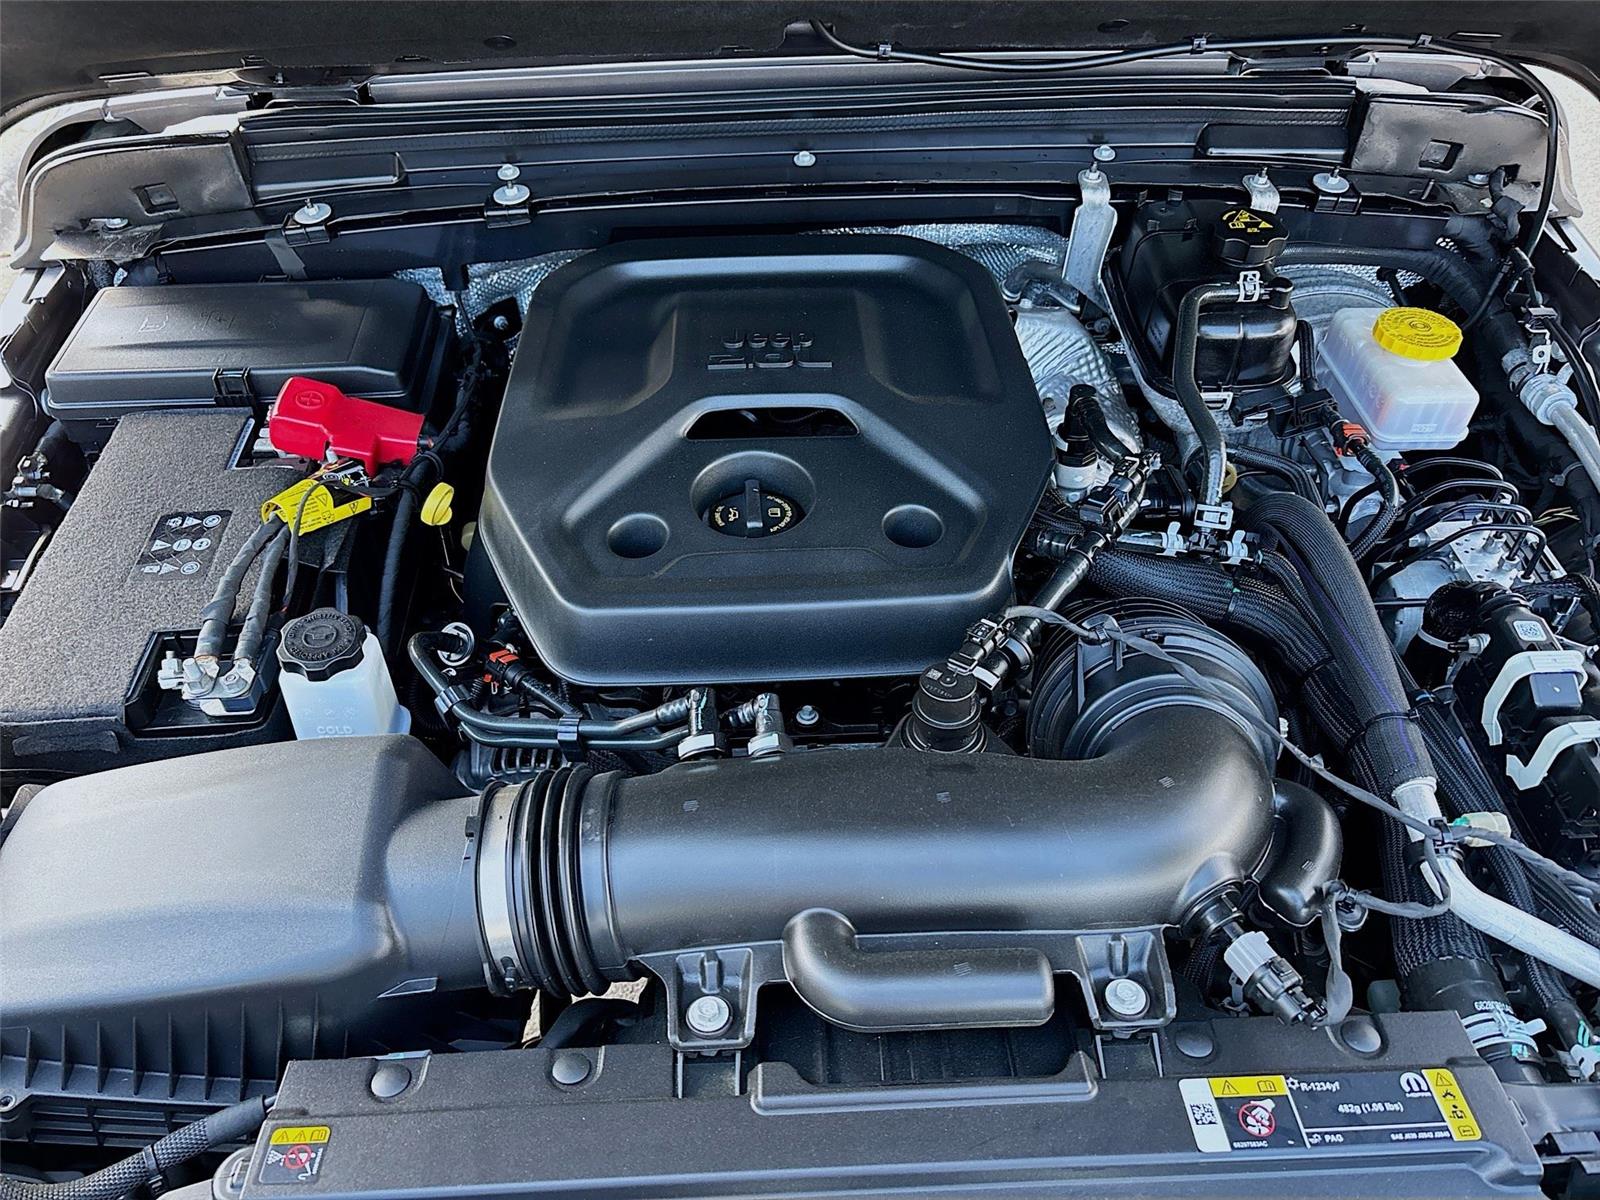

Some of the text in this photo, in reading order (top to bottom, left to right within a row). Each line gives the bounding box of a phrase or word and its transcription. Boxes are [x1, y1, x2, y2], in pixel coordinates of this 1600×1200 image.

[721, 327, 815, 351] Jeep
[707, 352, 833, 370] 2.0L
[316, 725, 353, 735] COLD
[1384, 1101, 1404, 1113] lbs)
[1324, 1134, 1344, 1143] PAG
